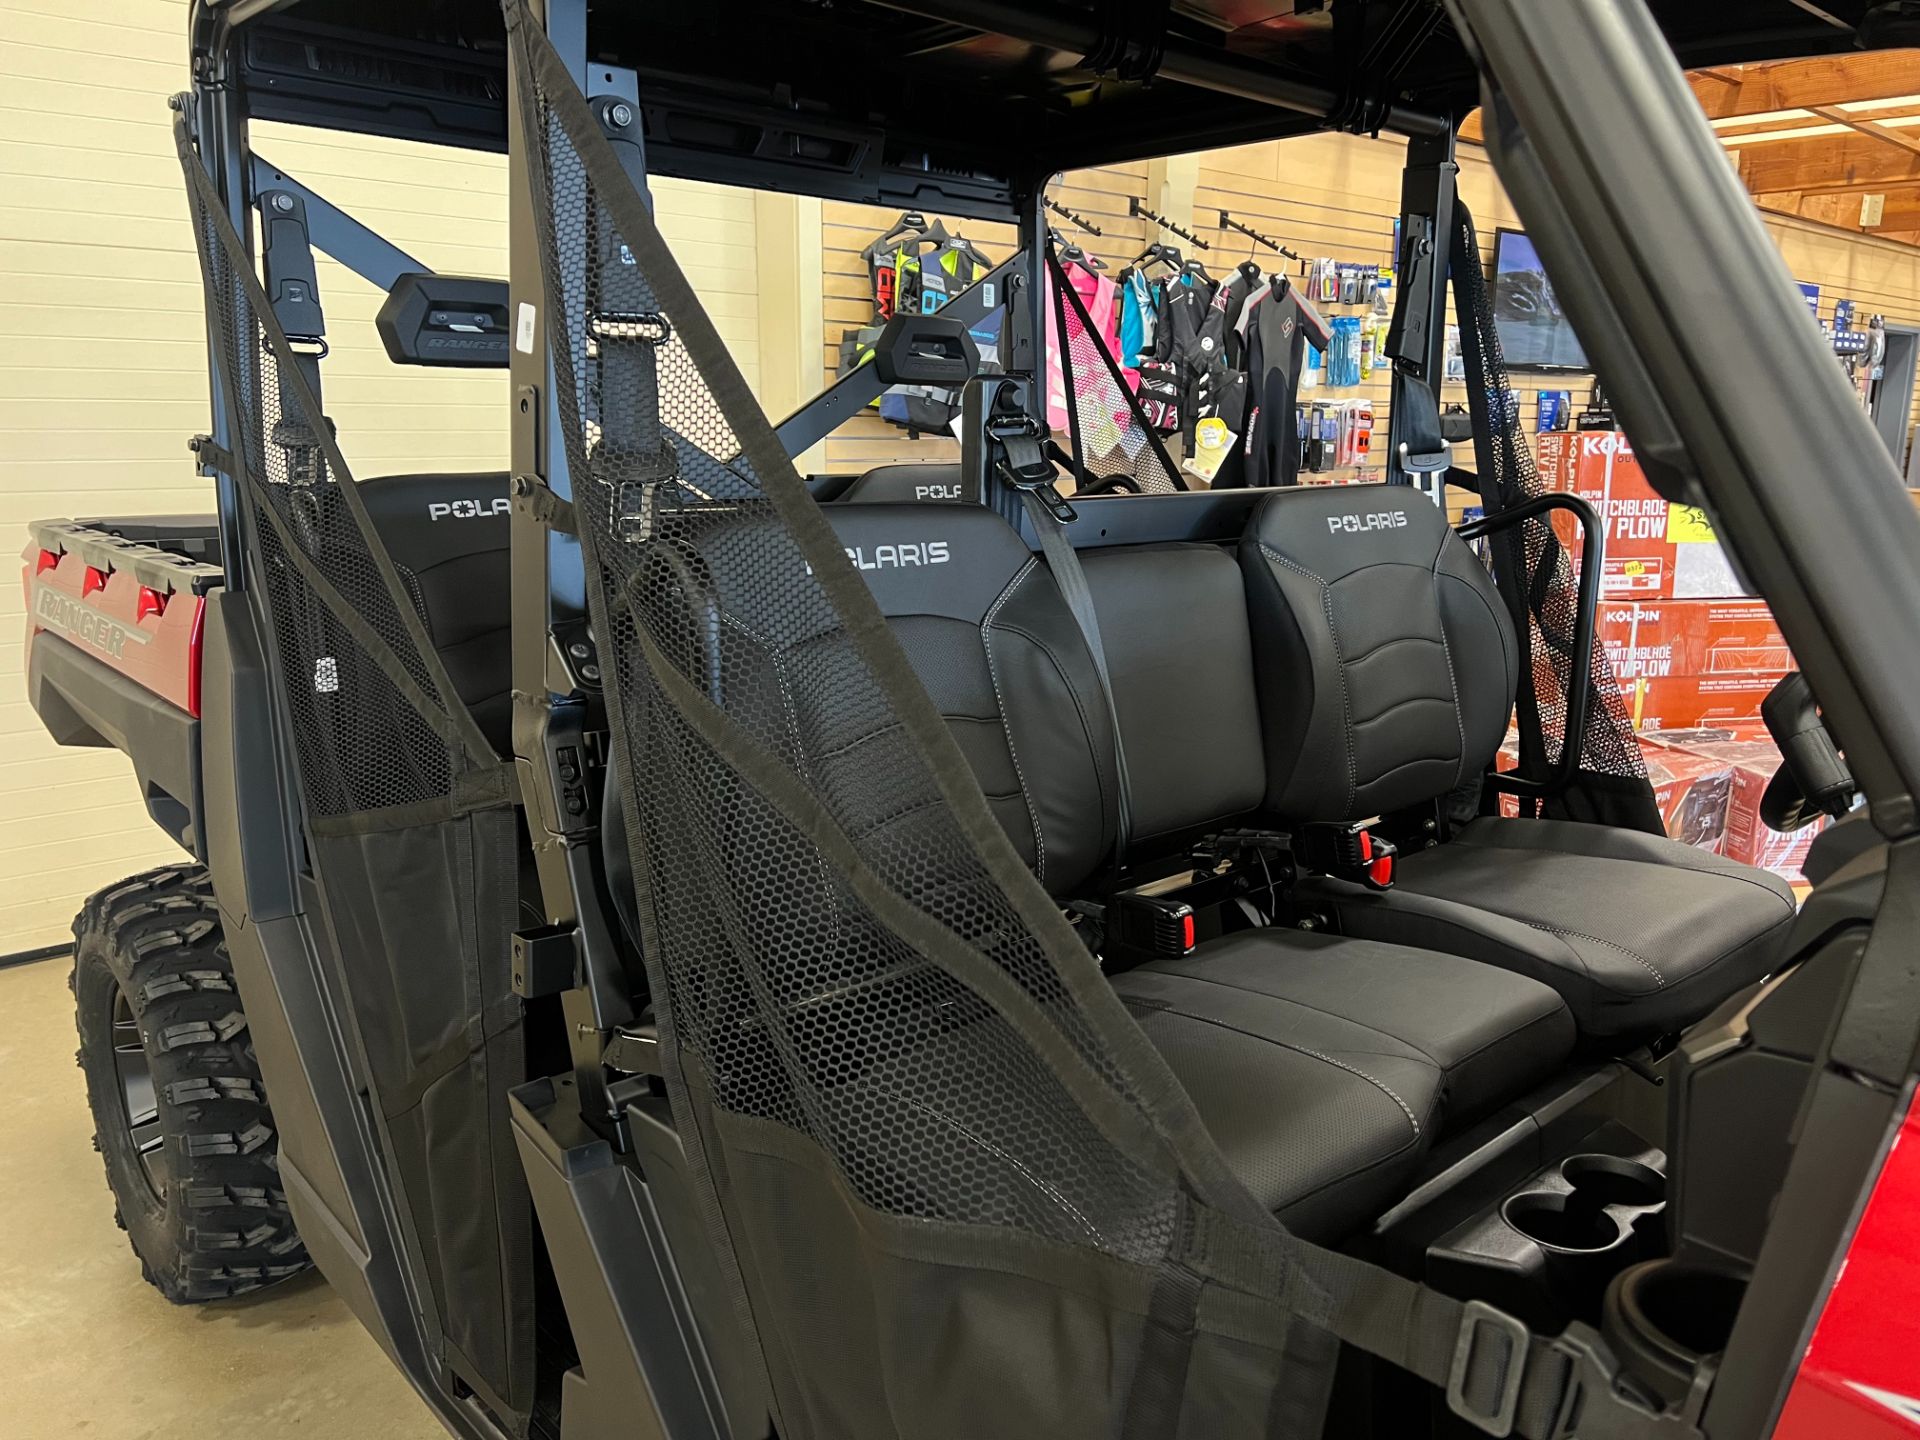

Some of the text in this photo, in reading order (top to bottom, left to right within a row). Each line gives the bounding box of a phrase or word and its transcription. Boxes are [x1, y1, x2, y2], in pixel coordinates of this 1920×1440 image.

[1583, 436, 1633, 456] KOL
[1548, 436, 1559, 489] SWITCHBL
[1567, 435, 1578, 492] KOLPIN
[915, 485, 962, 500] POLA
[428, 498, 511, 521] POLA
[1327, 511, 1408, 534] POLARIS
[1616, 517, 1667, 540] PLOW
[806, 541, 950, 575] LARIS
[38, 589, 127, 660] RANGER
[1606, 610, 1661, 624] KOLPIN
[1604, 647, 1672, 661] SWITHBLADE
[1632, 659, 1671, 677] PLOW
